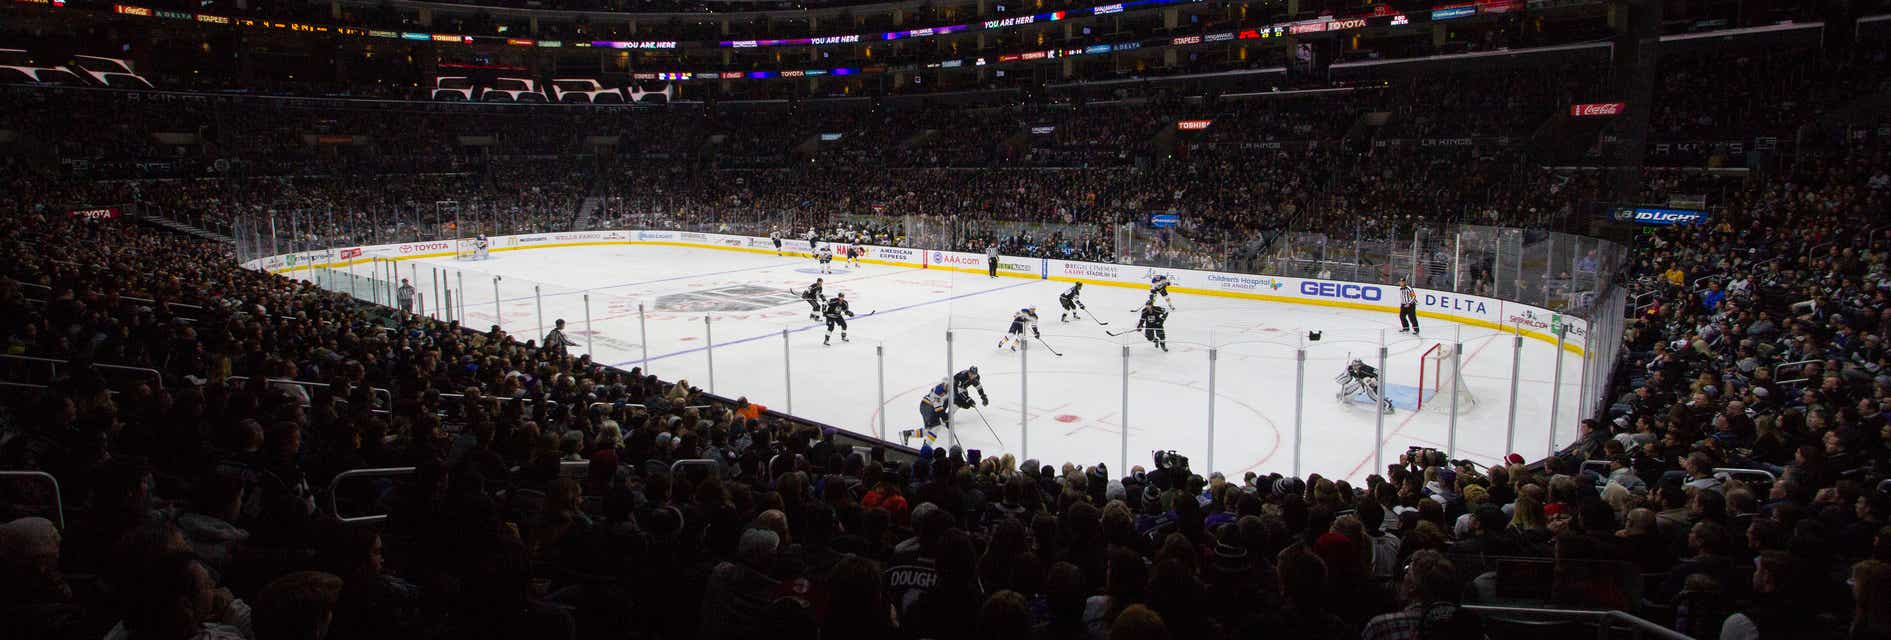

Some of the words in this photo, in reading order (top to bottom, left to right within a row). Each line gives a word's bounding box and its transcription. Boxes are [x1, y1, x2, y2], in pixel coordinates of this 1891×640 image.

[197, 14, 230, 24] STAPLES
[985, 20, 999, 28] YOU
[1000, 18, 1015, 26] ARE
[1015, 16, 1035, 24] HERE
[1328, 20, 1366, 30] TOYOTA
[1173, 36, 1201, 45] STAPLES
[1584, 103, 1618, 115] Coca-Cola
[1653, 212, 1700, 222] LIGHT
[415, 243, 448, 252] TOYOTA
[944, 256, 980, 265] AAA.com
[1241, 277, 1270, 287] Hospital
[1300, 281, 1382, 302] GEICO
[1425, 294, 1487, 315] DELTA
